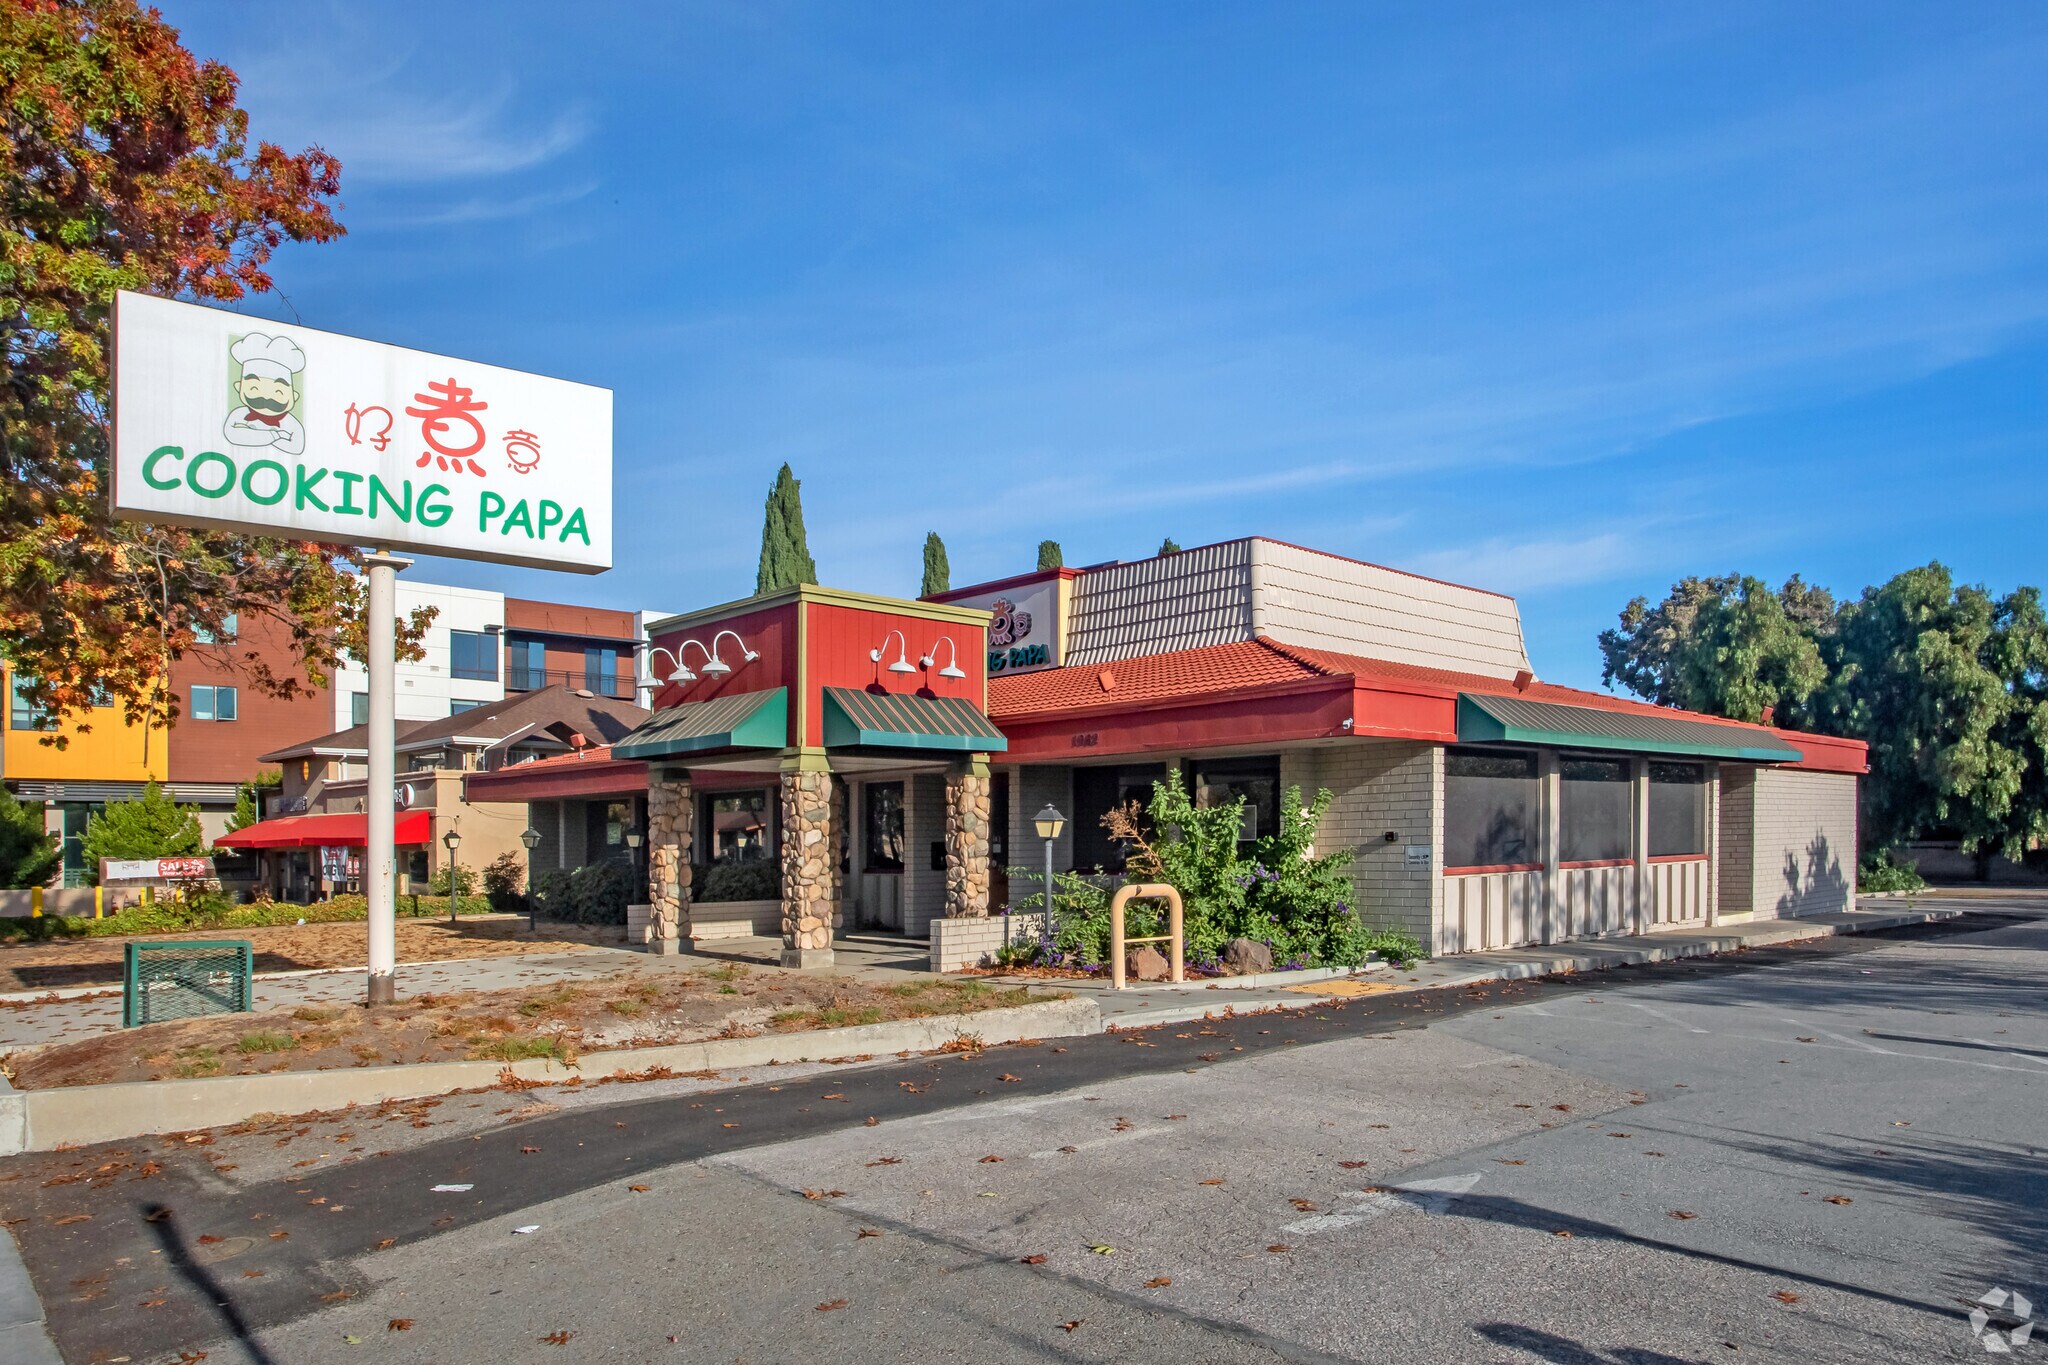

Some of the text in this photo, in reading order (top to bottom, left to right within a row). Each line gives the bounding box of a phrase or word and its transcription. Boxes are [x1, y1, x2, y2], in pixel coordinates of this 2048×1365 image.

[142, 445, 591, 547] COOKING PAPA
[1009, 643, 1048, 668] PAPA
